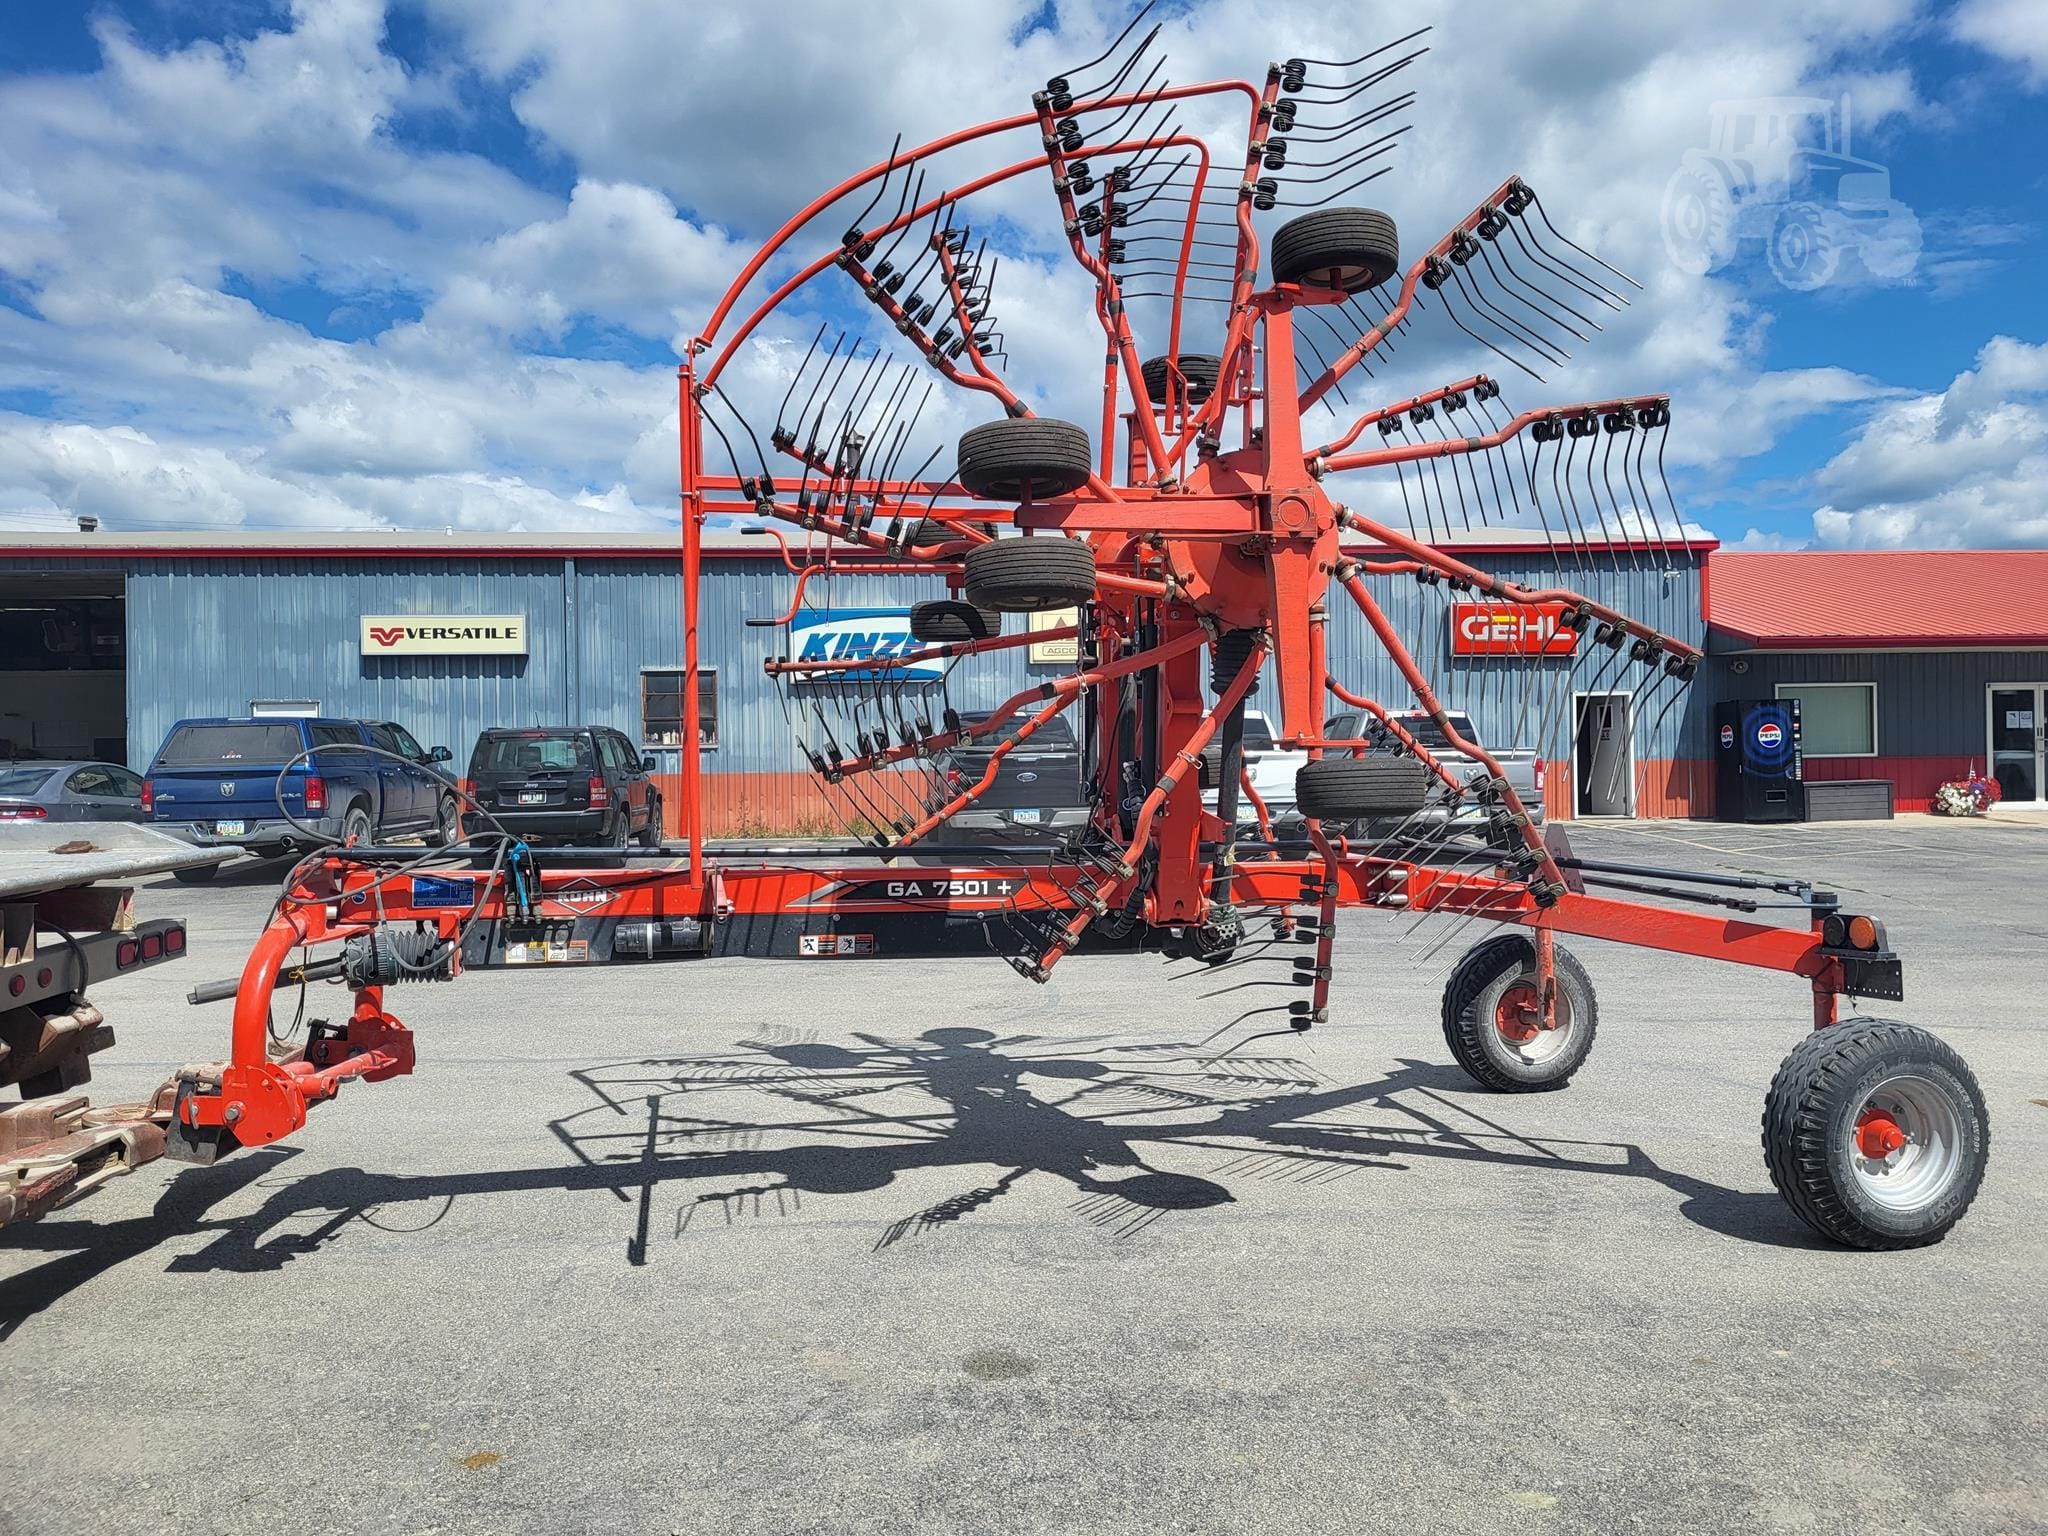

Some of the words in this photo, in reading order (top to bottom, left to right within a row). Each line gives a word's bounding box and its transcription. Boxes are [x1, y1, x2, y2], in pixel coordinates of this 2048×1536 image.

[405, 627, 518, 639] VERSATILE
[1461, 615, 1572, 640] GEHL
[887, 882, 923, 896] GA
[932, 880, 989, 896] 7501
